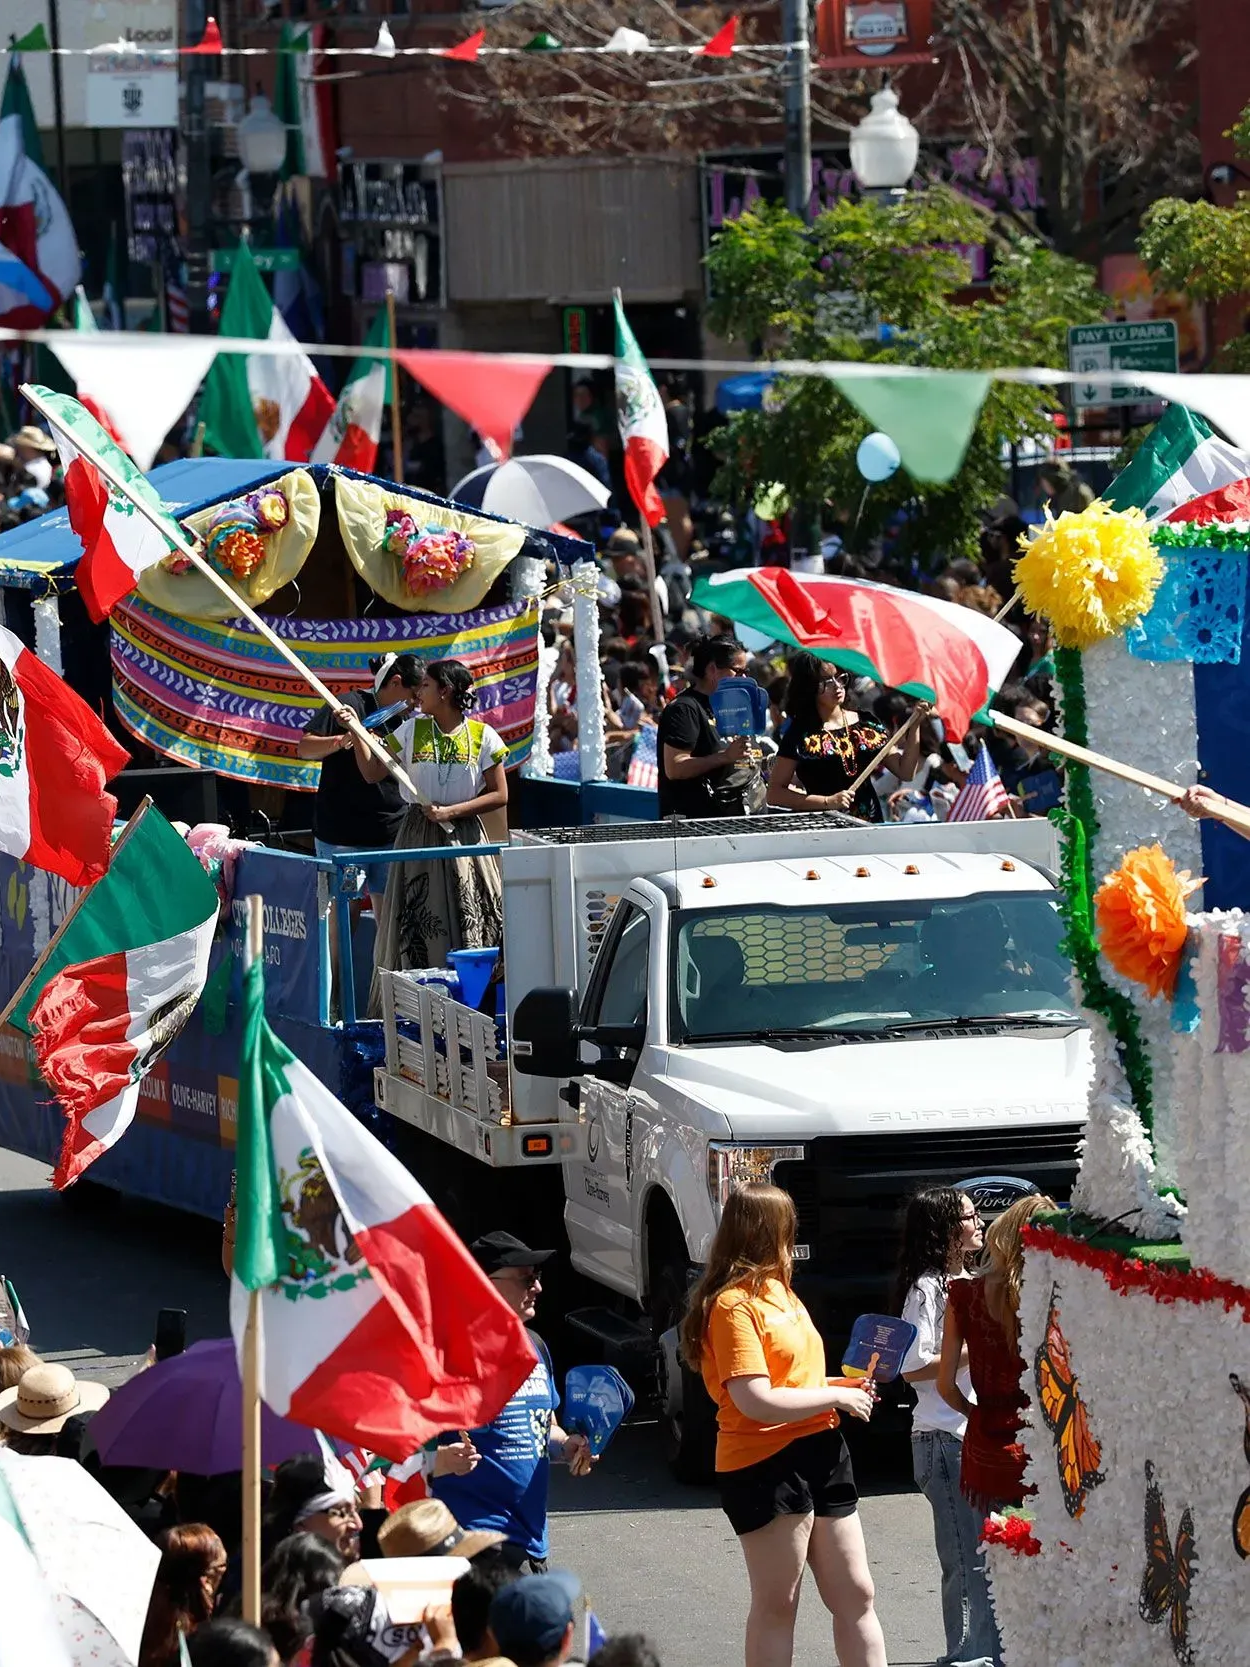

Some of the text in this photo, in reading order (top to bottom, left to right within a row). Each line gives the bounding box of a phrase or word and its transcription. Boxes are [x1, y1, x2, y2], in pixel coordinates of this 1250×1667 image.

[126, 27, 173, 42] Local
[1077, 324, 1167, 343] PAY TO PARK
[261, 904, 307, 940] OLLEGES
[171, 1083, 217, 1117] OLIVE-HARVEY
[867, 1106, 996, 1122] SUPER
[973, 1187, 1016, 1207] Ford
